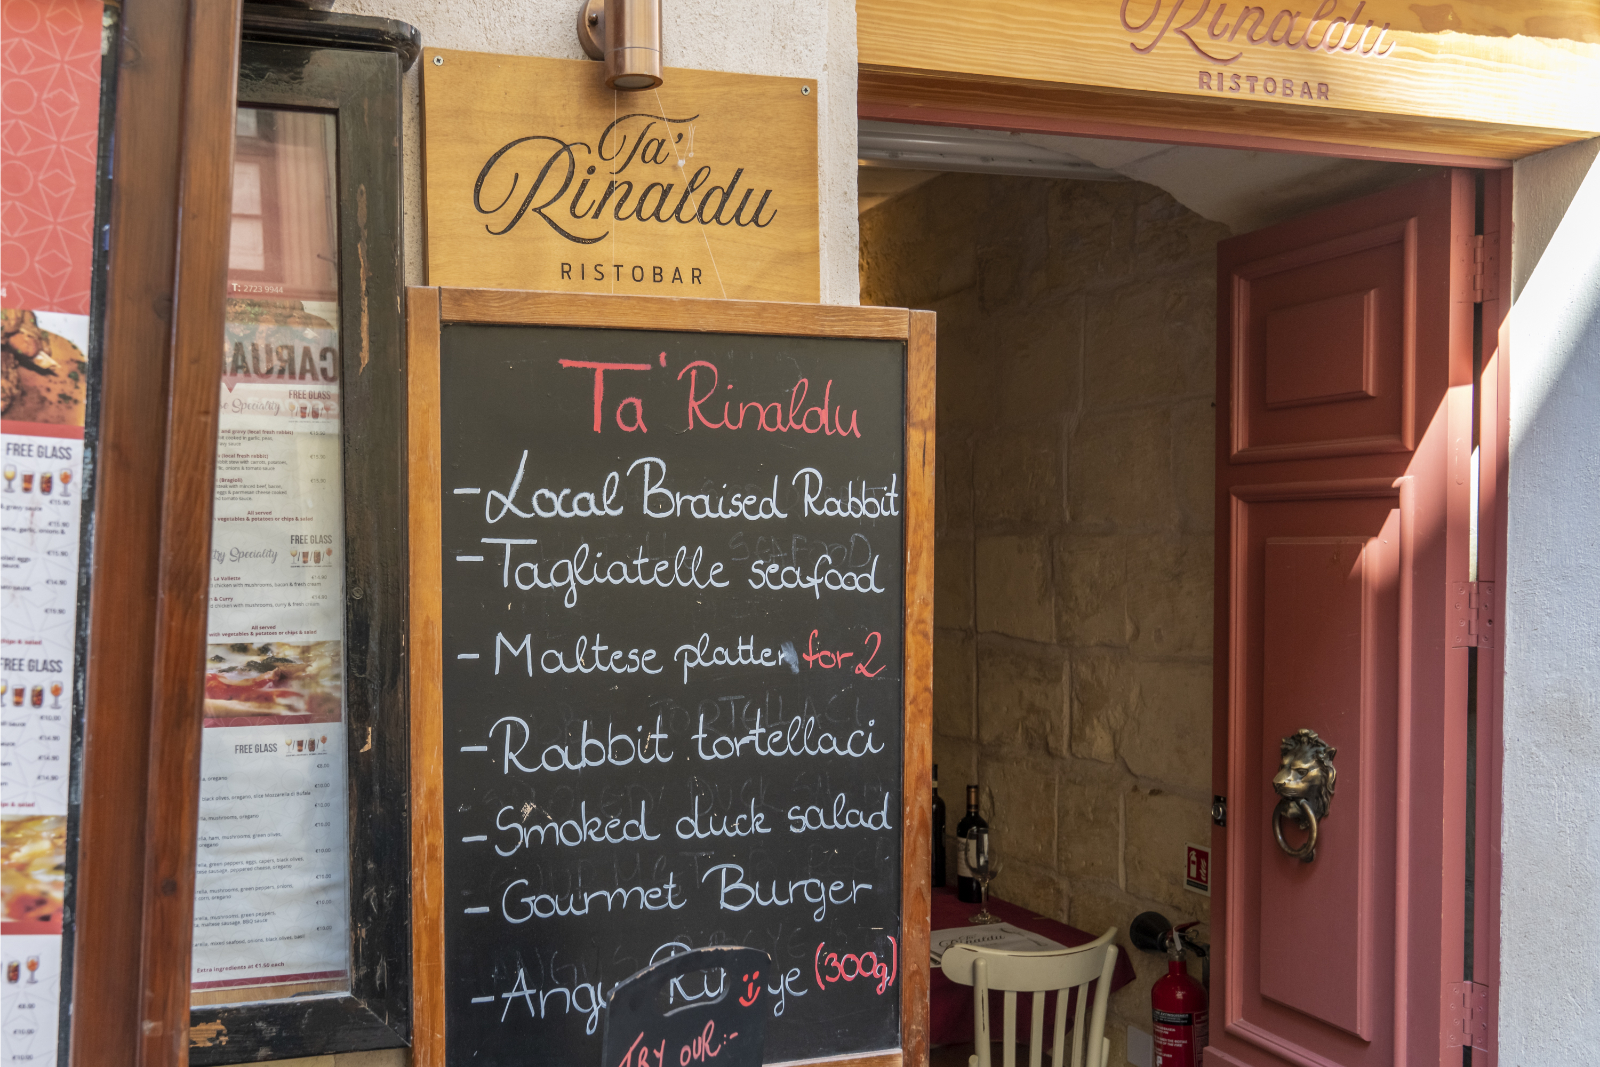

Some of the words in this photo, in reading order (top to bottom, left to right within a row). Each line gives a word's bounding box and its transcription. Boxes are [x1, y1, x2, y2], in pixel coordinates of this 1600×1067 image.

[1198, 71, 1331, 101] RISTOBAR
[473, 135, 778, 244] Rinaldu
[560, 262, 704, 285] RISTOBAR
[243, 284, 263, 293] 2723
[264, 285, 284, 293] 9944
[231, 398, 280, 416] Speciality
[288, 389, 306, 400] FREE
[308, 390, 331, 400] GLASS
[677, 360, 862, 439] Rinaldu
[6, 442, 34, 458] FREE
[37, 445, 73, 460] GLASS
[485, 450, 624, 524] Local
[626, 457, 788, 521] Braised
[792, 467, 899, 518] Rabbit
[290, 535, 308, 544] FREE
[310, 535, 333, 544] GLASS
[229, 546, 278, 564] Speciality
[480, 538, 730, 608] Tagliatelle
[748, 554, 885, 600] seafood
[0, 658, 25, 672] FREE
[28, 659, 63, 673] GLASS
[494, 632, 663, 677] Maltese
[674, 632, 786, 685] platter
[802, 629, 854, 669] for
[855, 631, 886, 678] 2
[235, 744, 253, 754] FREE
[254, 743, 277, 753] GLASS
[488, 715, 674, 774] Rabbit
[691, 708, 885, 760] tortellaci
[494, 800, 661, 857] Smoked
[676, 795, 772, 839] duck
[787, 792, 893, 833] salad
[502, 872, 687, 924] Gourmet
[702, 863, 873, 922] Burger
